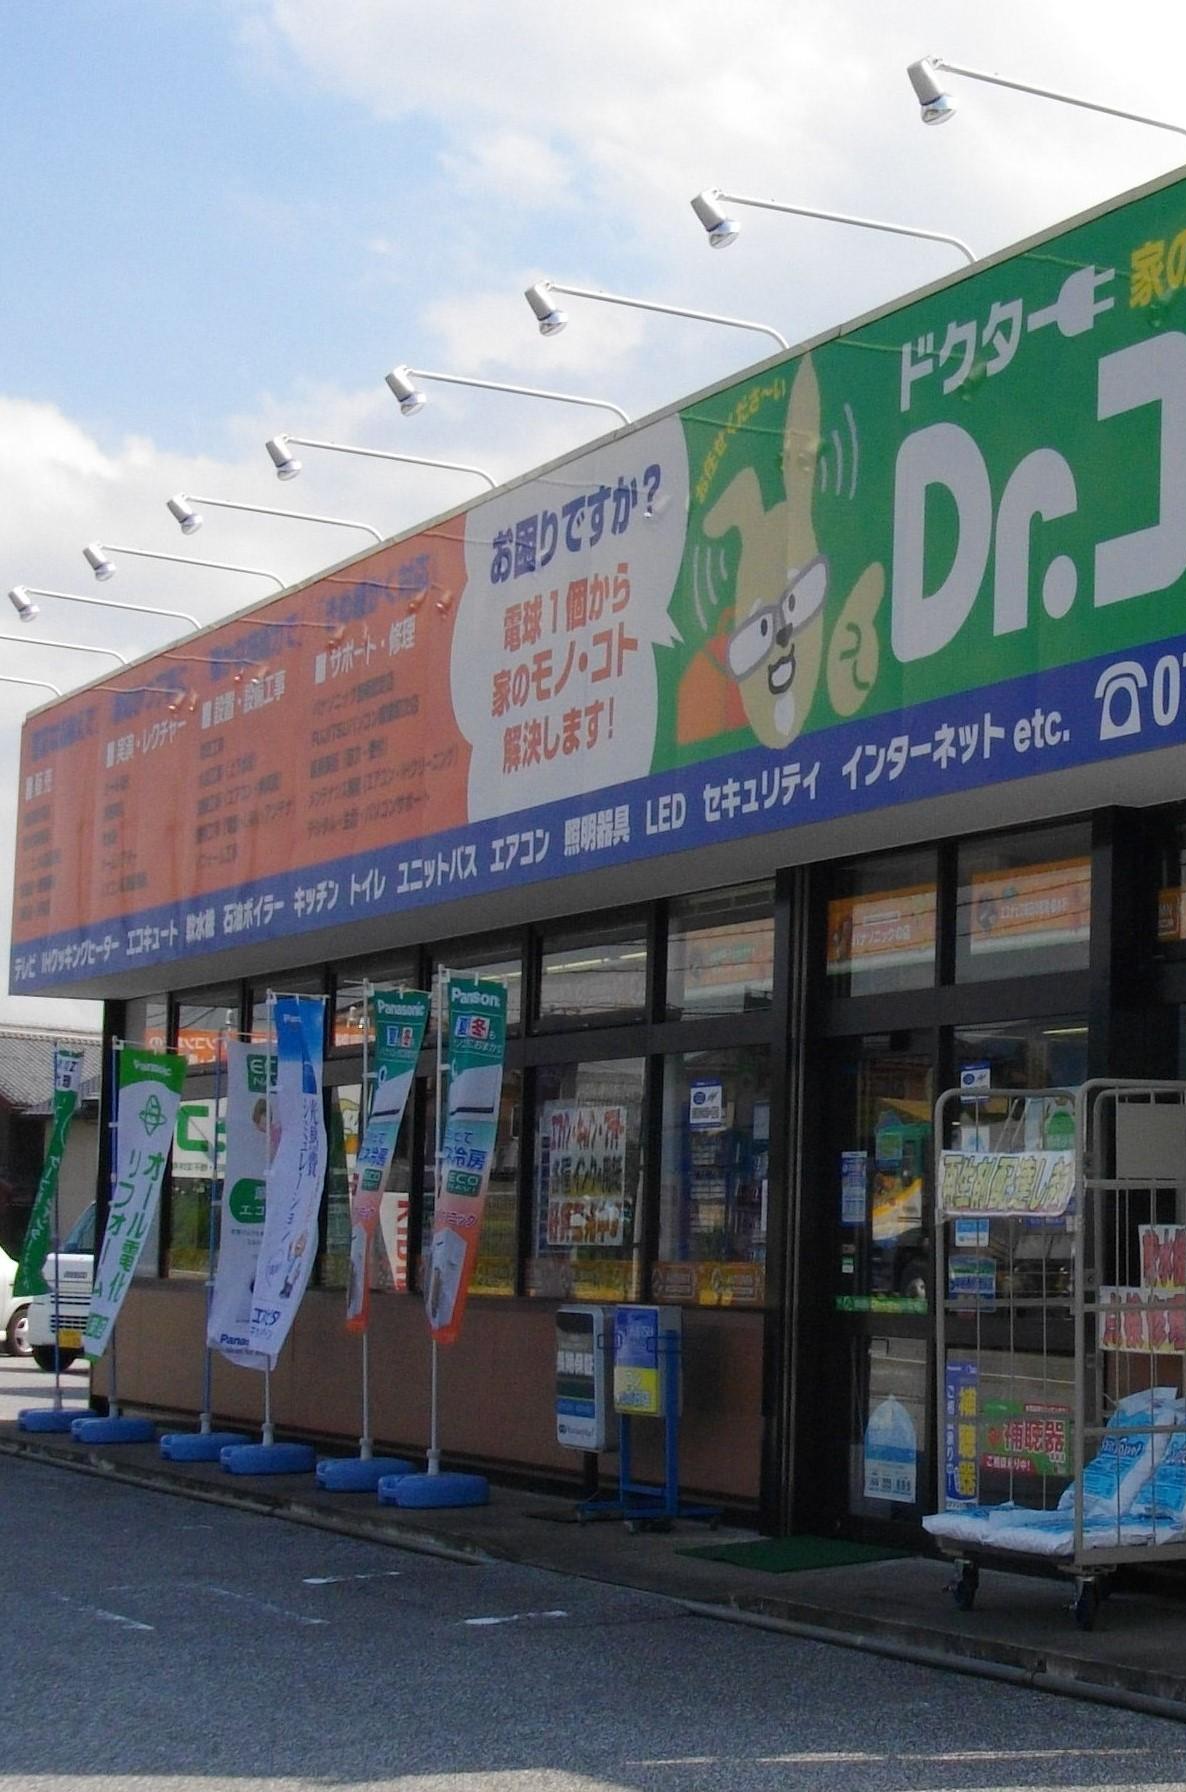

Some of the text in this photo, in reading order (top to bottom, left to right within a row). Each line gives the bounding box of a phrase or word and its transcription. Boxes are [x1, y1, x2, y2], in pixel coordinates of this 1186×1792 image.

[293, 880, 340, 919] キッチン
[350, 868, 387, 906] トイレ
[397, 844, 478, 895] ユニットバス
[490, 828, 550, 873] エアコン
[564, 804, 632, 857] 照明器具
[646, 792, 686, 835] LED
[704, 761, 821, 823] セキュリティ
[842, 713, 1005, 791] インターネット
[1014, 709, 1071, 753] etc.
